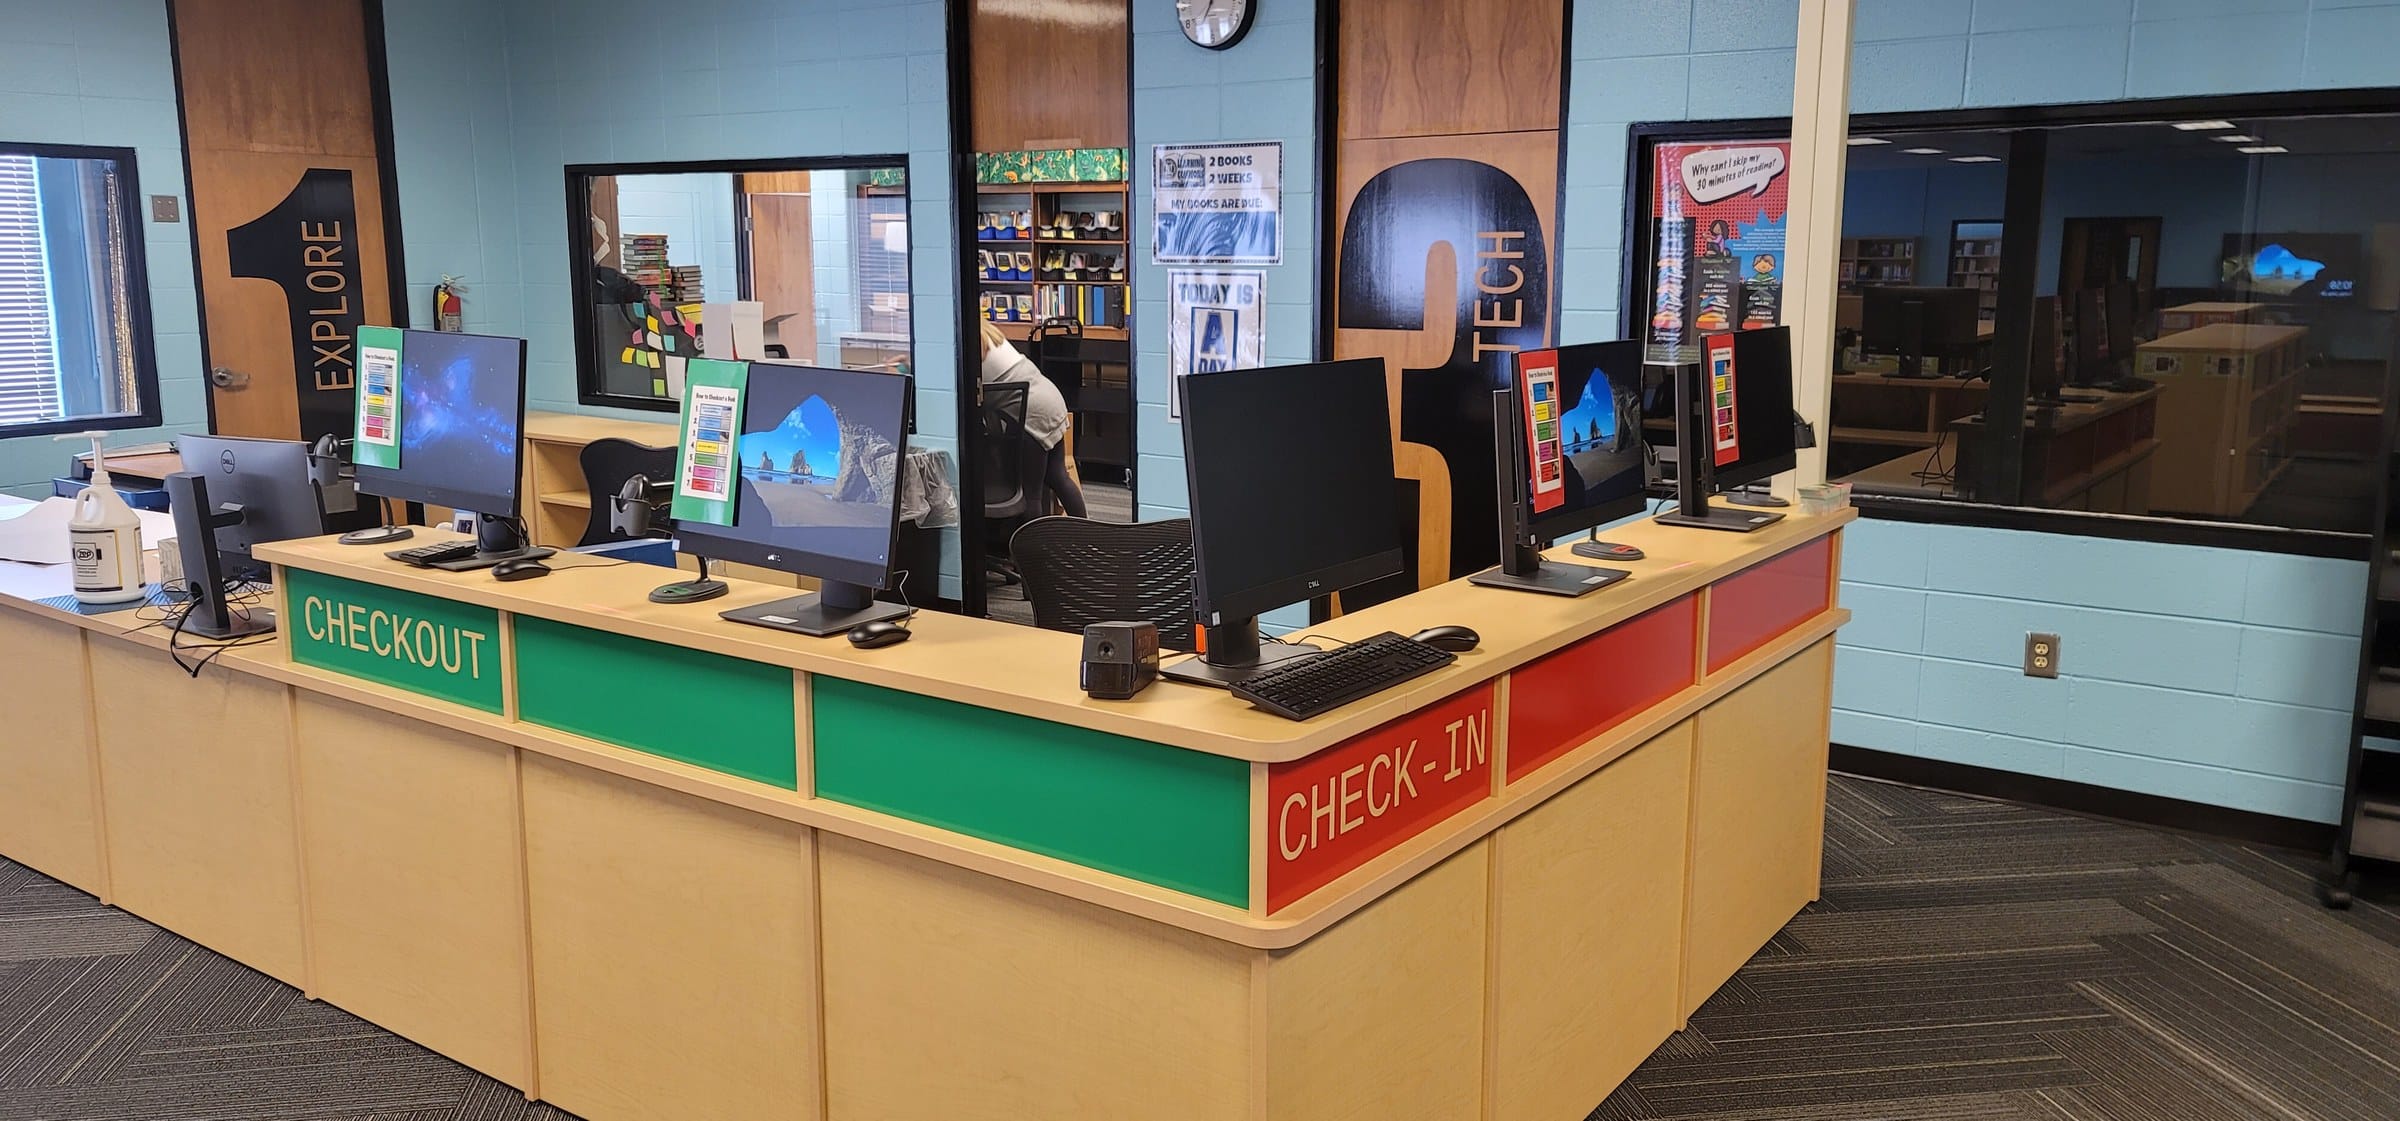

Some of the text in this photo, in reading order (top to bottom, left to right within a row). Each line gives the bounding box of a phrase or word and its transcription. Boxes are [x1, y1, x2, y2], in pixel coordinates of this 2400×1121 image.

[1209, 156, 1252, 167] 2 BOOKS
[1692, 164, 1709, 176] Why
[1728, 158, 1732, 168] I
[1732, 156, 1748, 167] skip
[1749, 154, 1760, 162] my
[1696, 158, 1776, 191] 30 minutes of reading?
[1209, 173, 1252, 184] 2 WEEKS
[1172, 200, 1184, 209] MY
[1187, 199, 1219, 209] BOOKS
[1221, 199, 1239, 208] ARE
[301, 221, 354, 391] EXPLORE
[1178, 282, 1254, 304] TODAY IS
[1472, 231, 1525, 363] TECH
[1200, 311, 1227, 354] A
[1198, 358, 1228, 374] DAY
[304, 596, 485, 679] CHECKOUT
[1279, 709, 1486, 861] CHECK-IN
